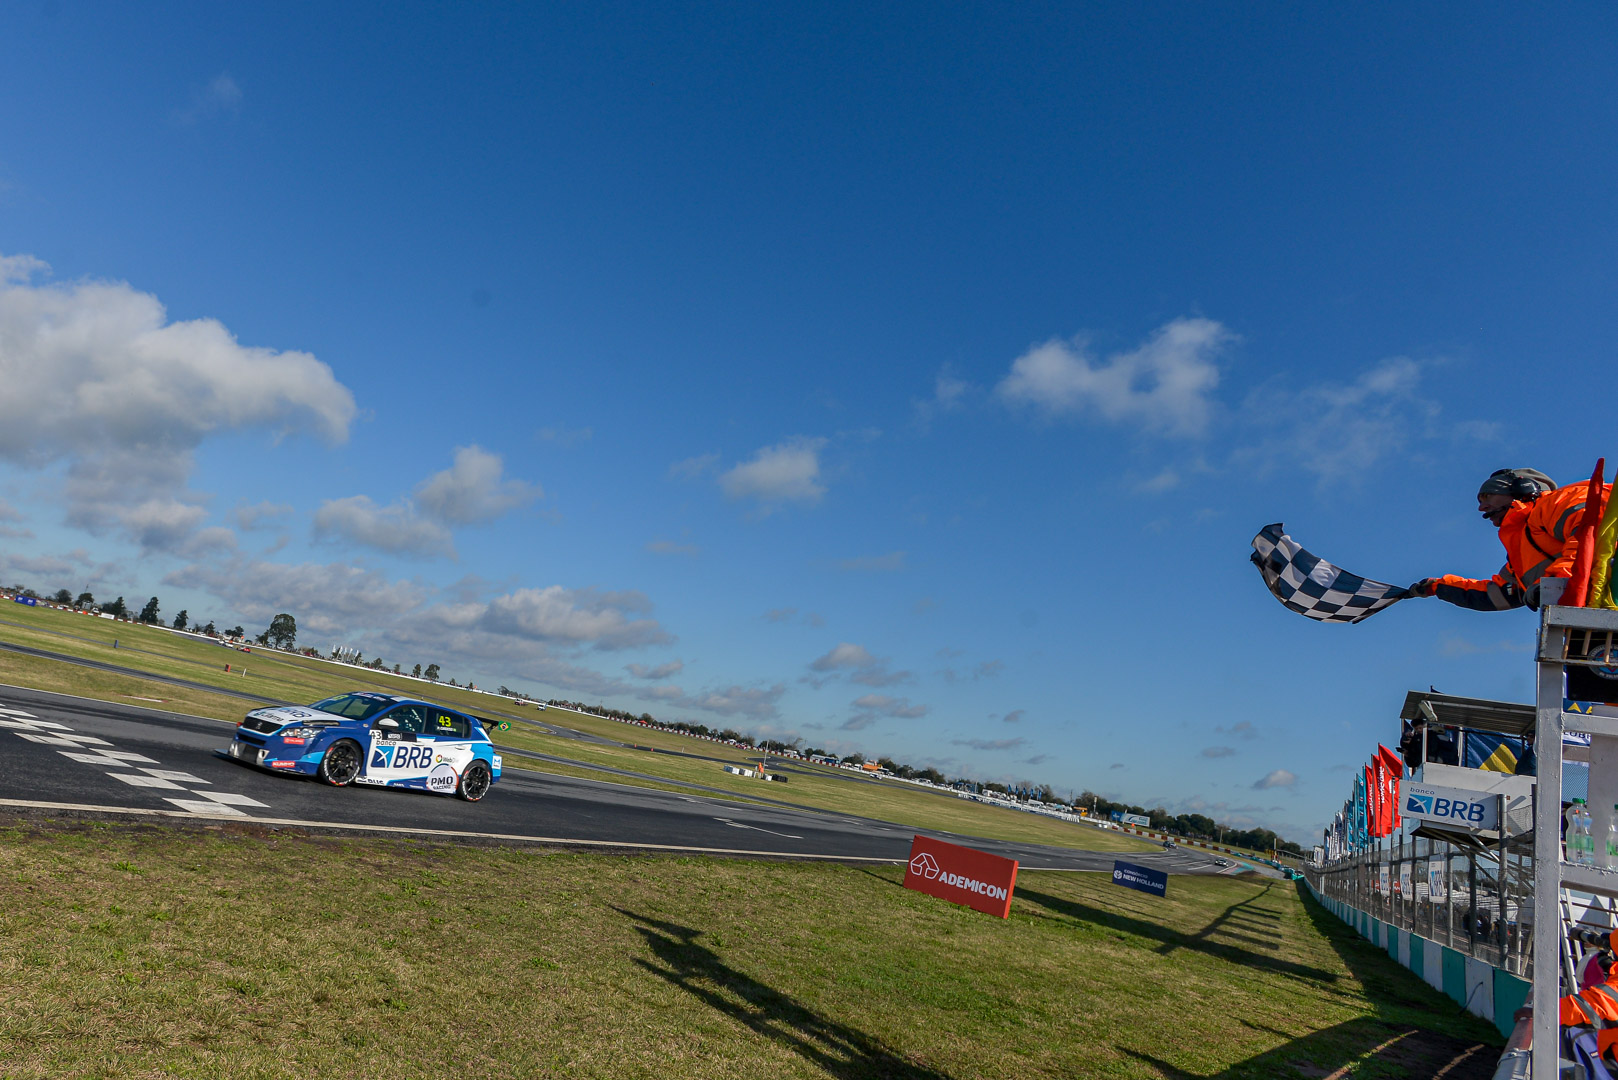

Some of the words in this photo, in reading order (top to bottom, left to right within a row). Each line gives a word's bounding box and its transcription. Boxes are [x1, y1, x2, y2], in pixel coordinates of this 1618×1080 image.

[438, 715, 452, 727] 43
[393, 746, 434, 769] BRB
[431, 776, 454, 786] PMO
[1409, 787, 1435, 796] banco
[1433, 797, 1486, 823] BRB
[938, 871, 1008, 901] ADEMICON
[1122, 873, 1137, 882] NEW
[1136, 878, 1165, 890] HOLLAND
